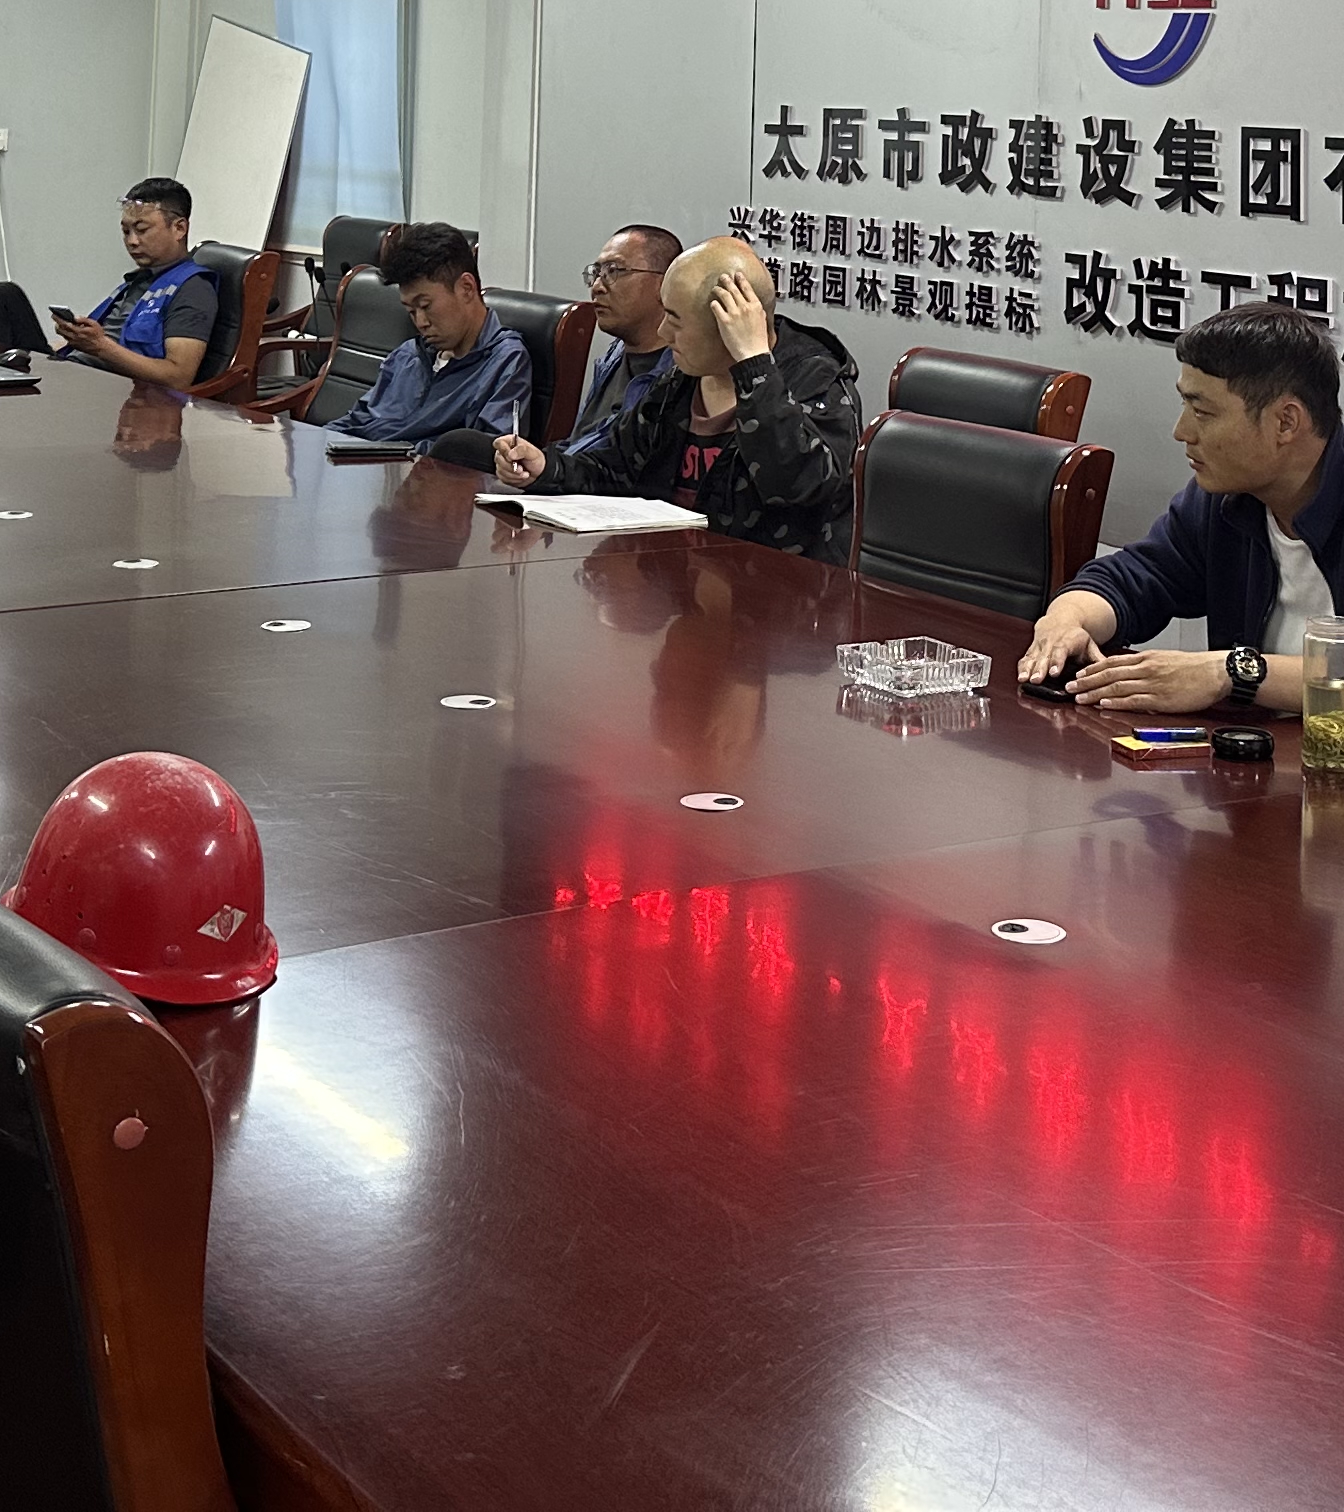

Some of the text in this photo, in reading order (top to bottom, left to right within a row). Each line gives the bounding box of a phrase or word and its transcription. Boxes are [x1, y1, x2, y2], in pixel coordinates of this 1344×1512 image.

[728, 206, 1042, 279] 兴华街周边排水系统
